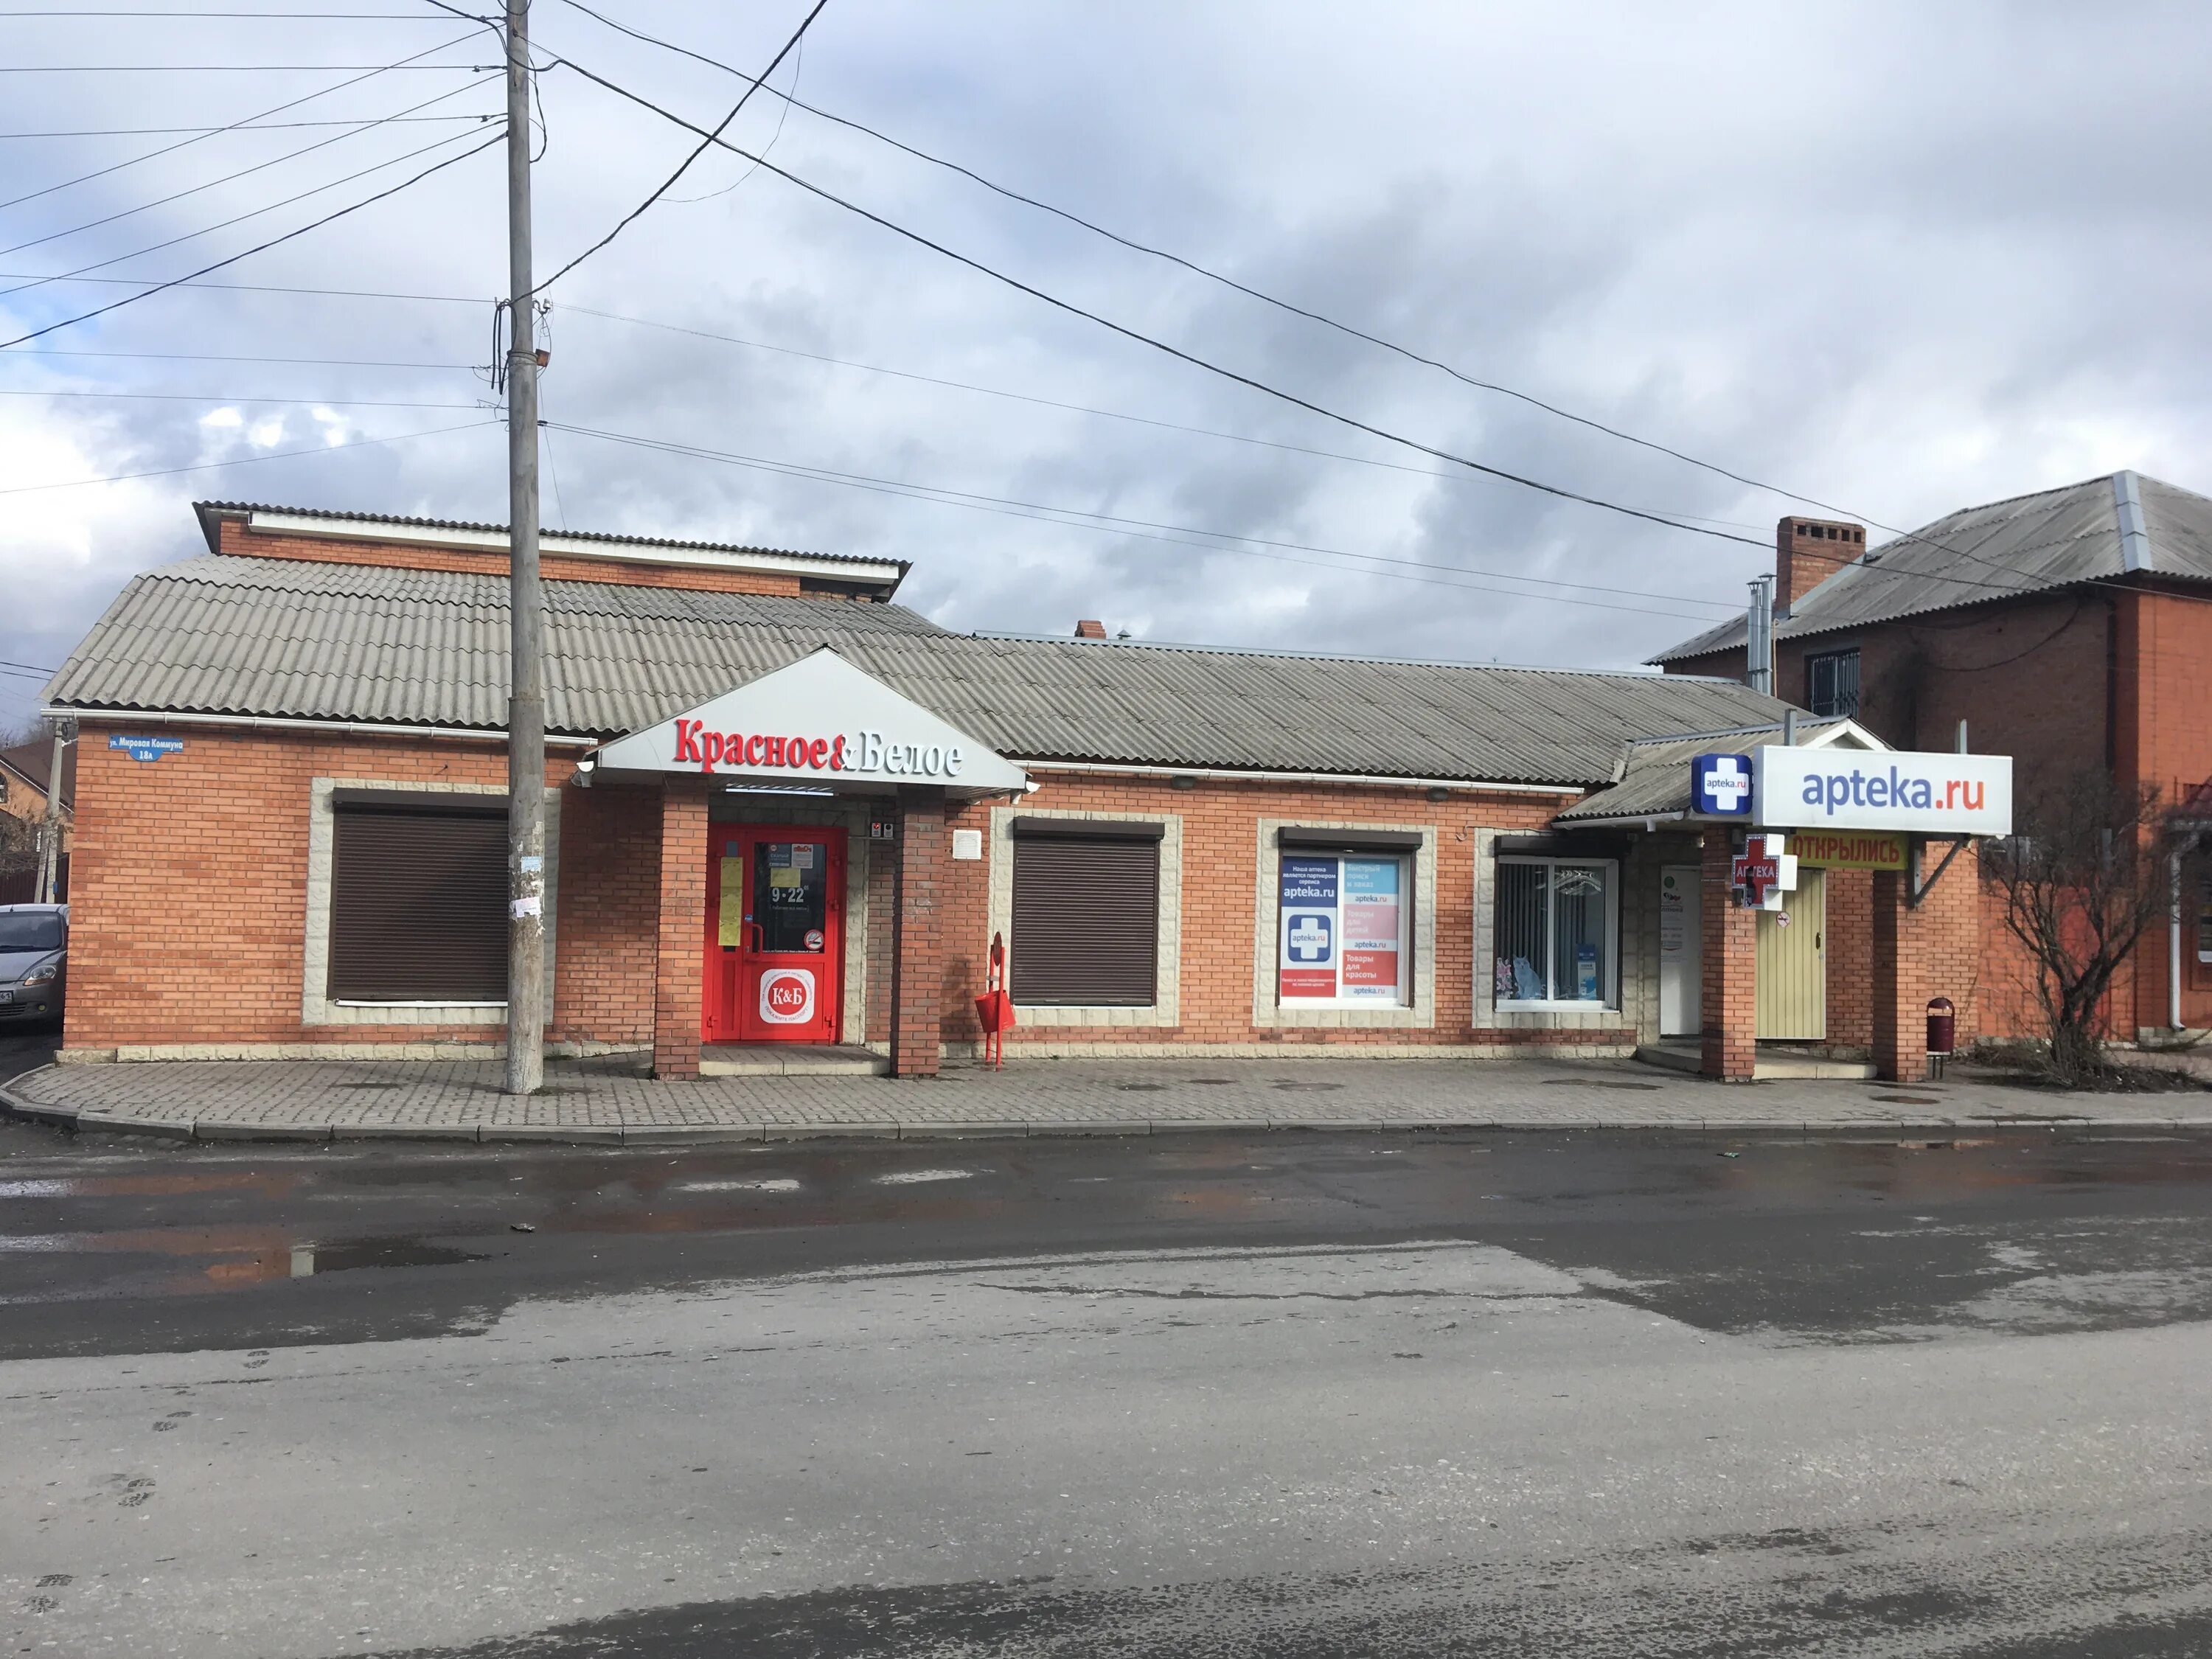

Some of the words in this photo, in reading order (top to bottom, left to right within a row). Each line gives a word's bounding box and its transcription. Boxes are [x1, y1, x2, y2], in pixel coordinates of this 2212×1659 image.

[119, 737, 150, 749] Мировая
[151, 738, 184, 751] Коммуна
[1706, 778, 1747, 789] apteka.ru
[1802, 765, 1985, 815] apteka.ru
[1792, 835, 1900, 863] ОТКРЫЛИСЬ
[1283, 886, 1335, 900] apteka.ru
[1355, 894, 1388, 903] apteka.ru
[1293, 933, 1326, 943] apteka.ru
[1354, 940, 1386, 949] apteka.ru
[1346, 954, 1374, 964] Товары
[772, 987, 803, 1005] К&Б
[1353, 987, 1385, 995] apteka.ru
